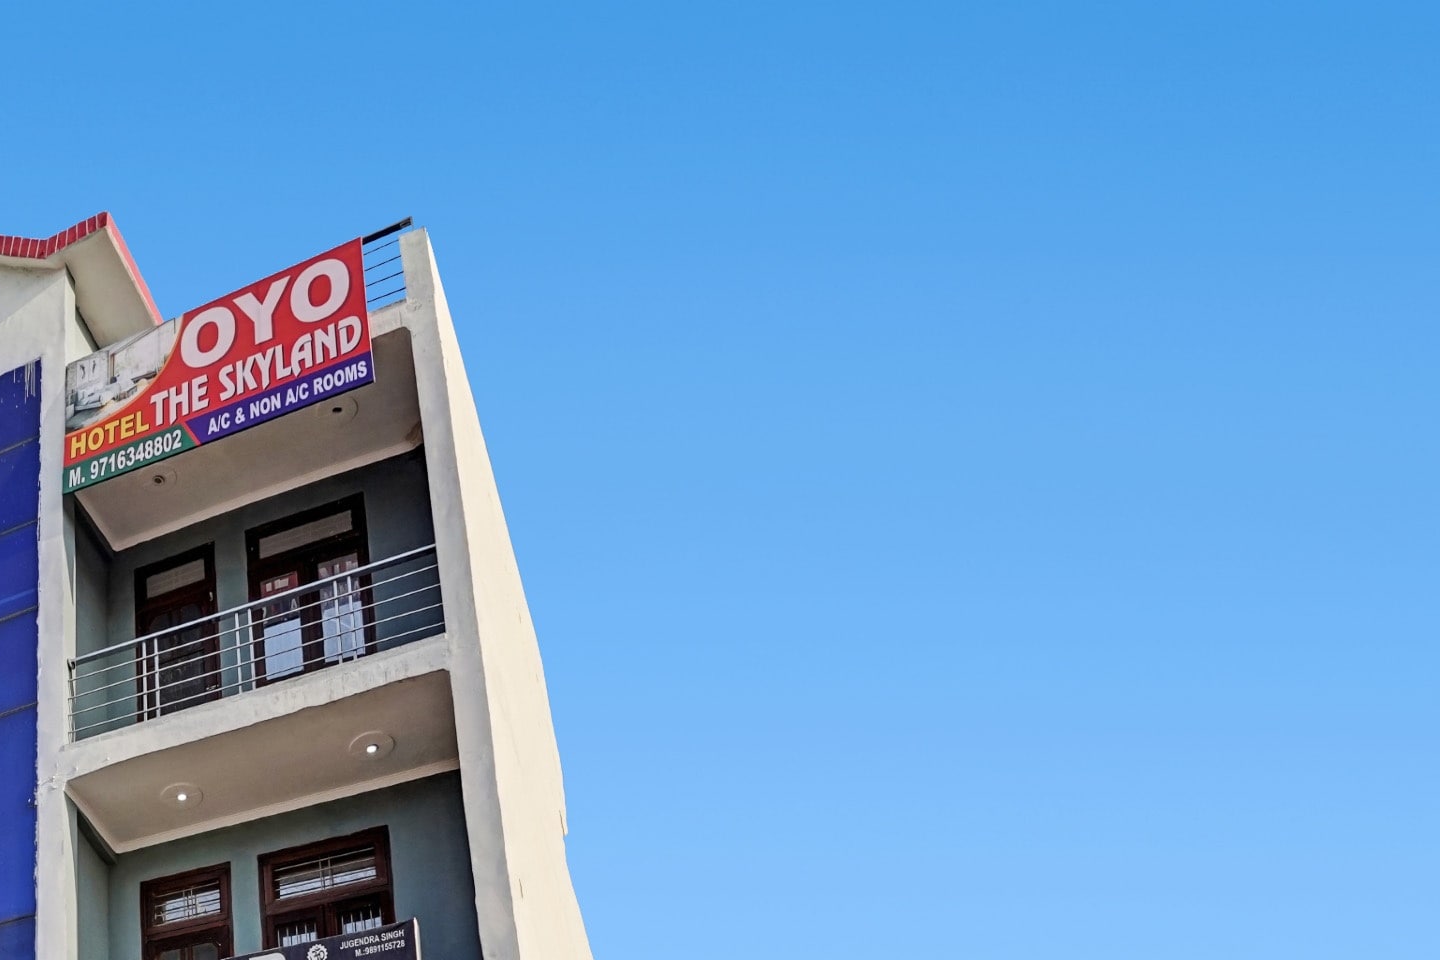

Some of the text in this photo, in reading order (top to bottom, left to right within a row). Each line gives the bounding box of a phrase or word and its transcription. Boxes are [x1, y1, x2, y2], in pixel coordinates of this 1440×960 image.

[180, 258, 350, 368] OYO
[70, 315, 362, 459] HOTEL THE SKYLAND
[207, 360, 368, 435] A/C & NON A/C ROOMS
[68, 429, 182, 488] M. 9716348802
[340, 929, 405, 950] JUGENDRA SINGH
